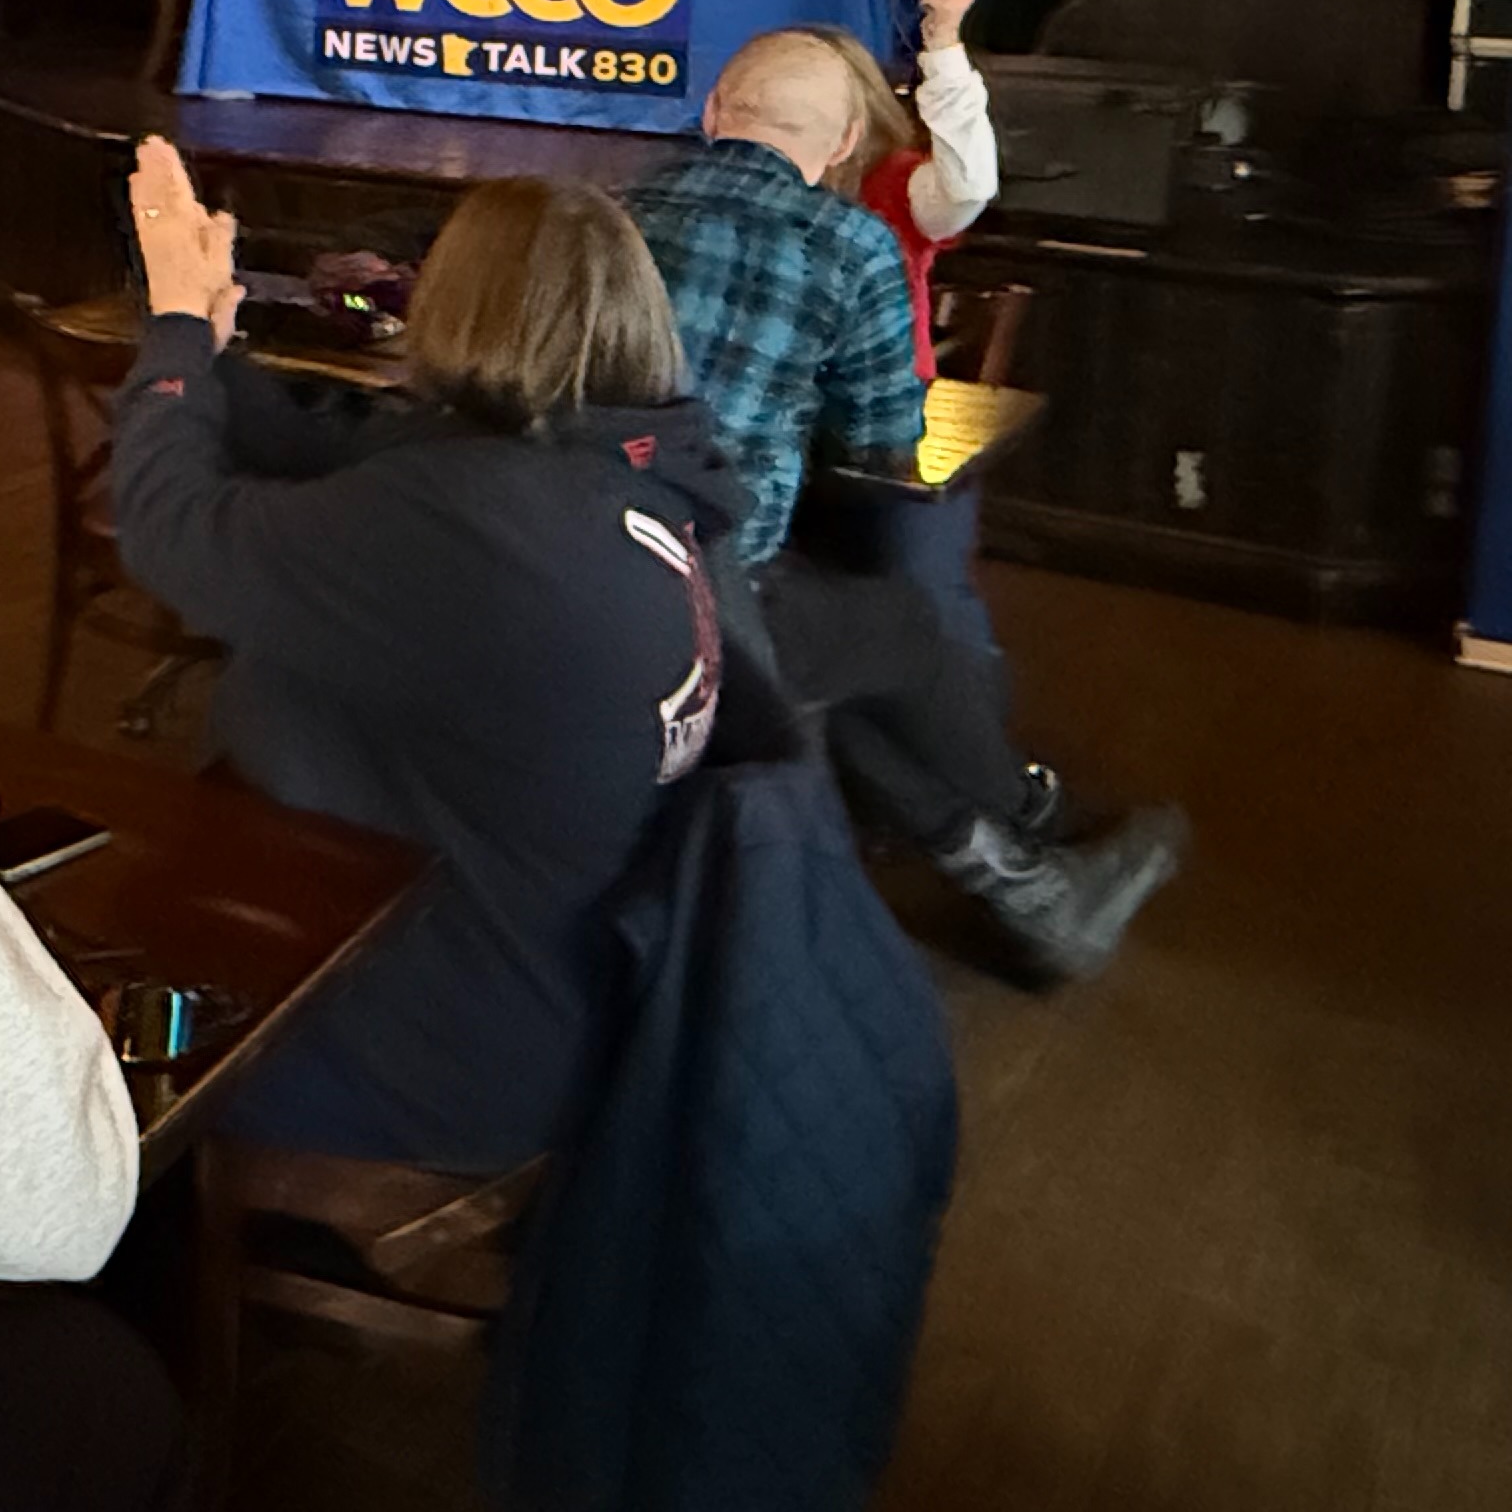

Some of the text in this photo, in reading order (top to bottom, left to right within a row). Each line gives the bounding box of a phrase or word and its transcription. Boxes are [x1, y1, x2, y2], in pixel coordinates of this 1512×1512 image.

[323, 28, 678, 86] NEWS TALK 830
